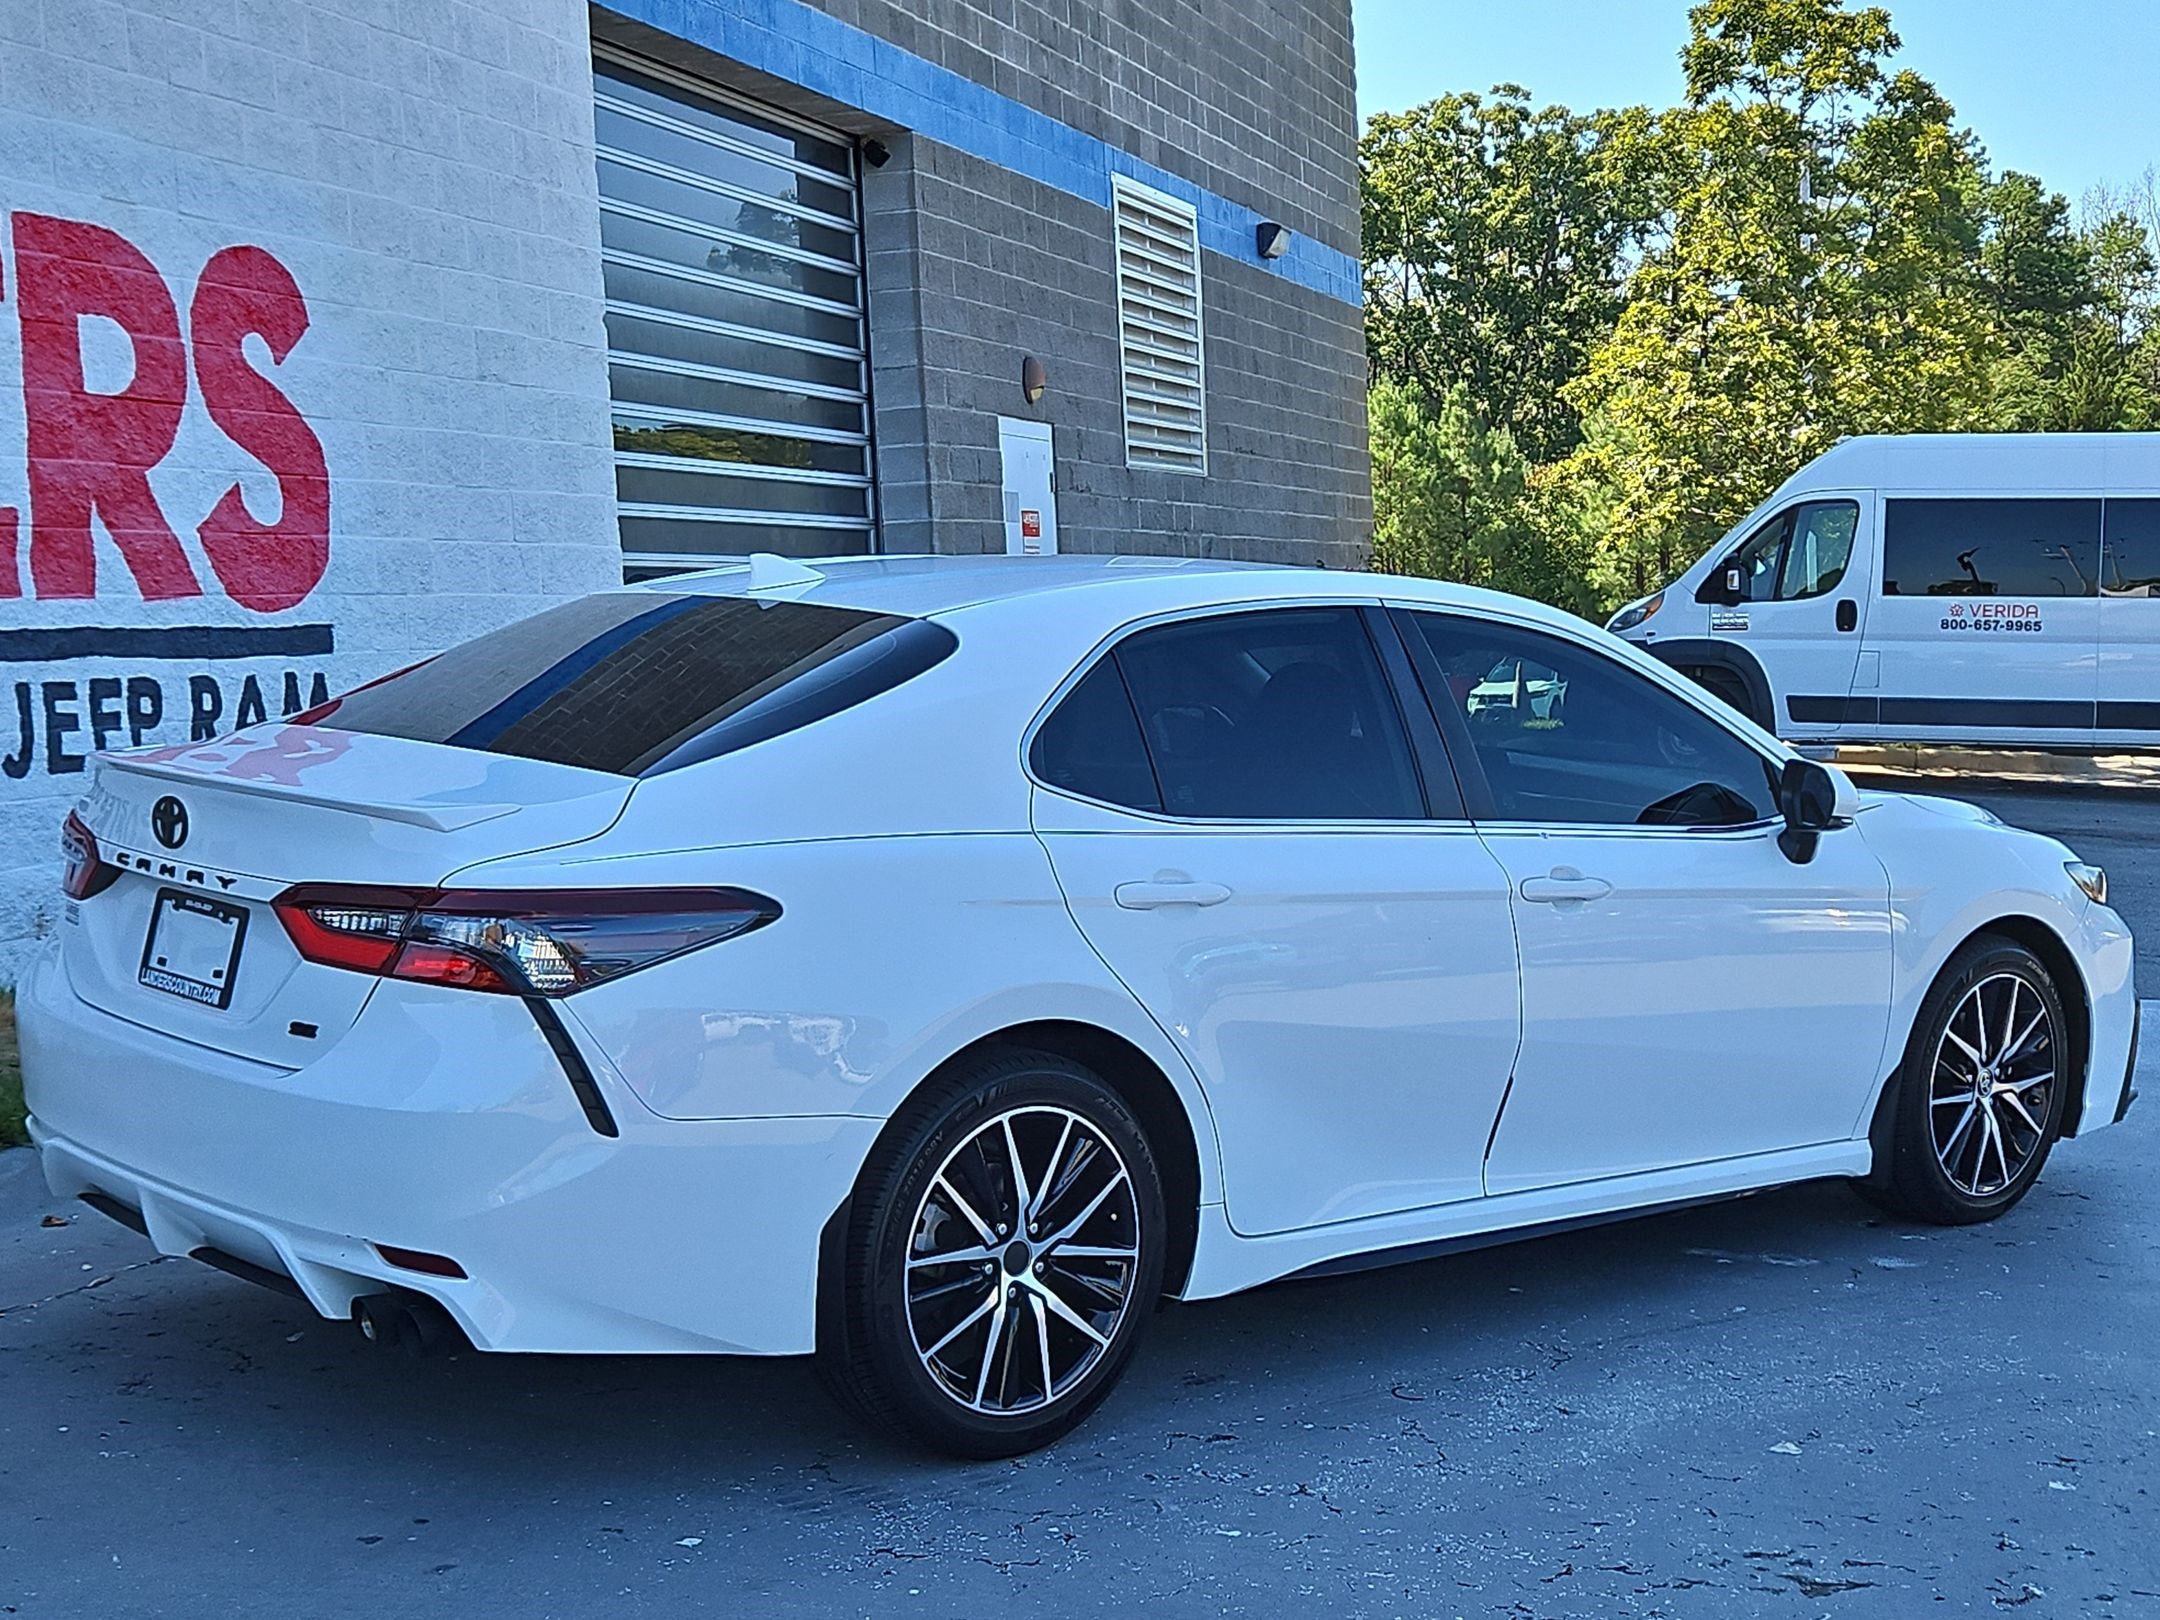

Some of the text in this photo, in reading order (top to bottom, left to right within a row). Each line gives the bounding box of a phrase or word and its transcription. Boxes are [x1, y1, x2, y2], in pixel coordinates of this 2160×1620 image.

[0, 211, 331, 613] RS
[1940, 619, 2042, 632] 800-657-9965
[1969, 604, 2039, 618] VERIDA
[2, 676, 163, 779] JEEP
[116, 852, 238, 890] CAMRY
